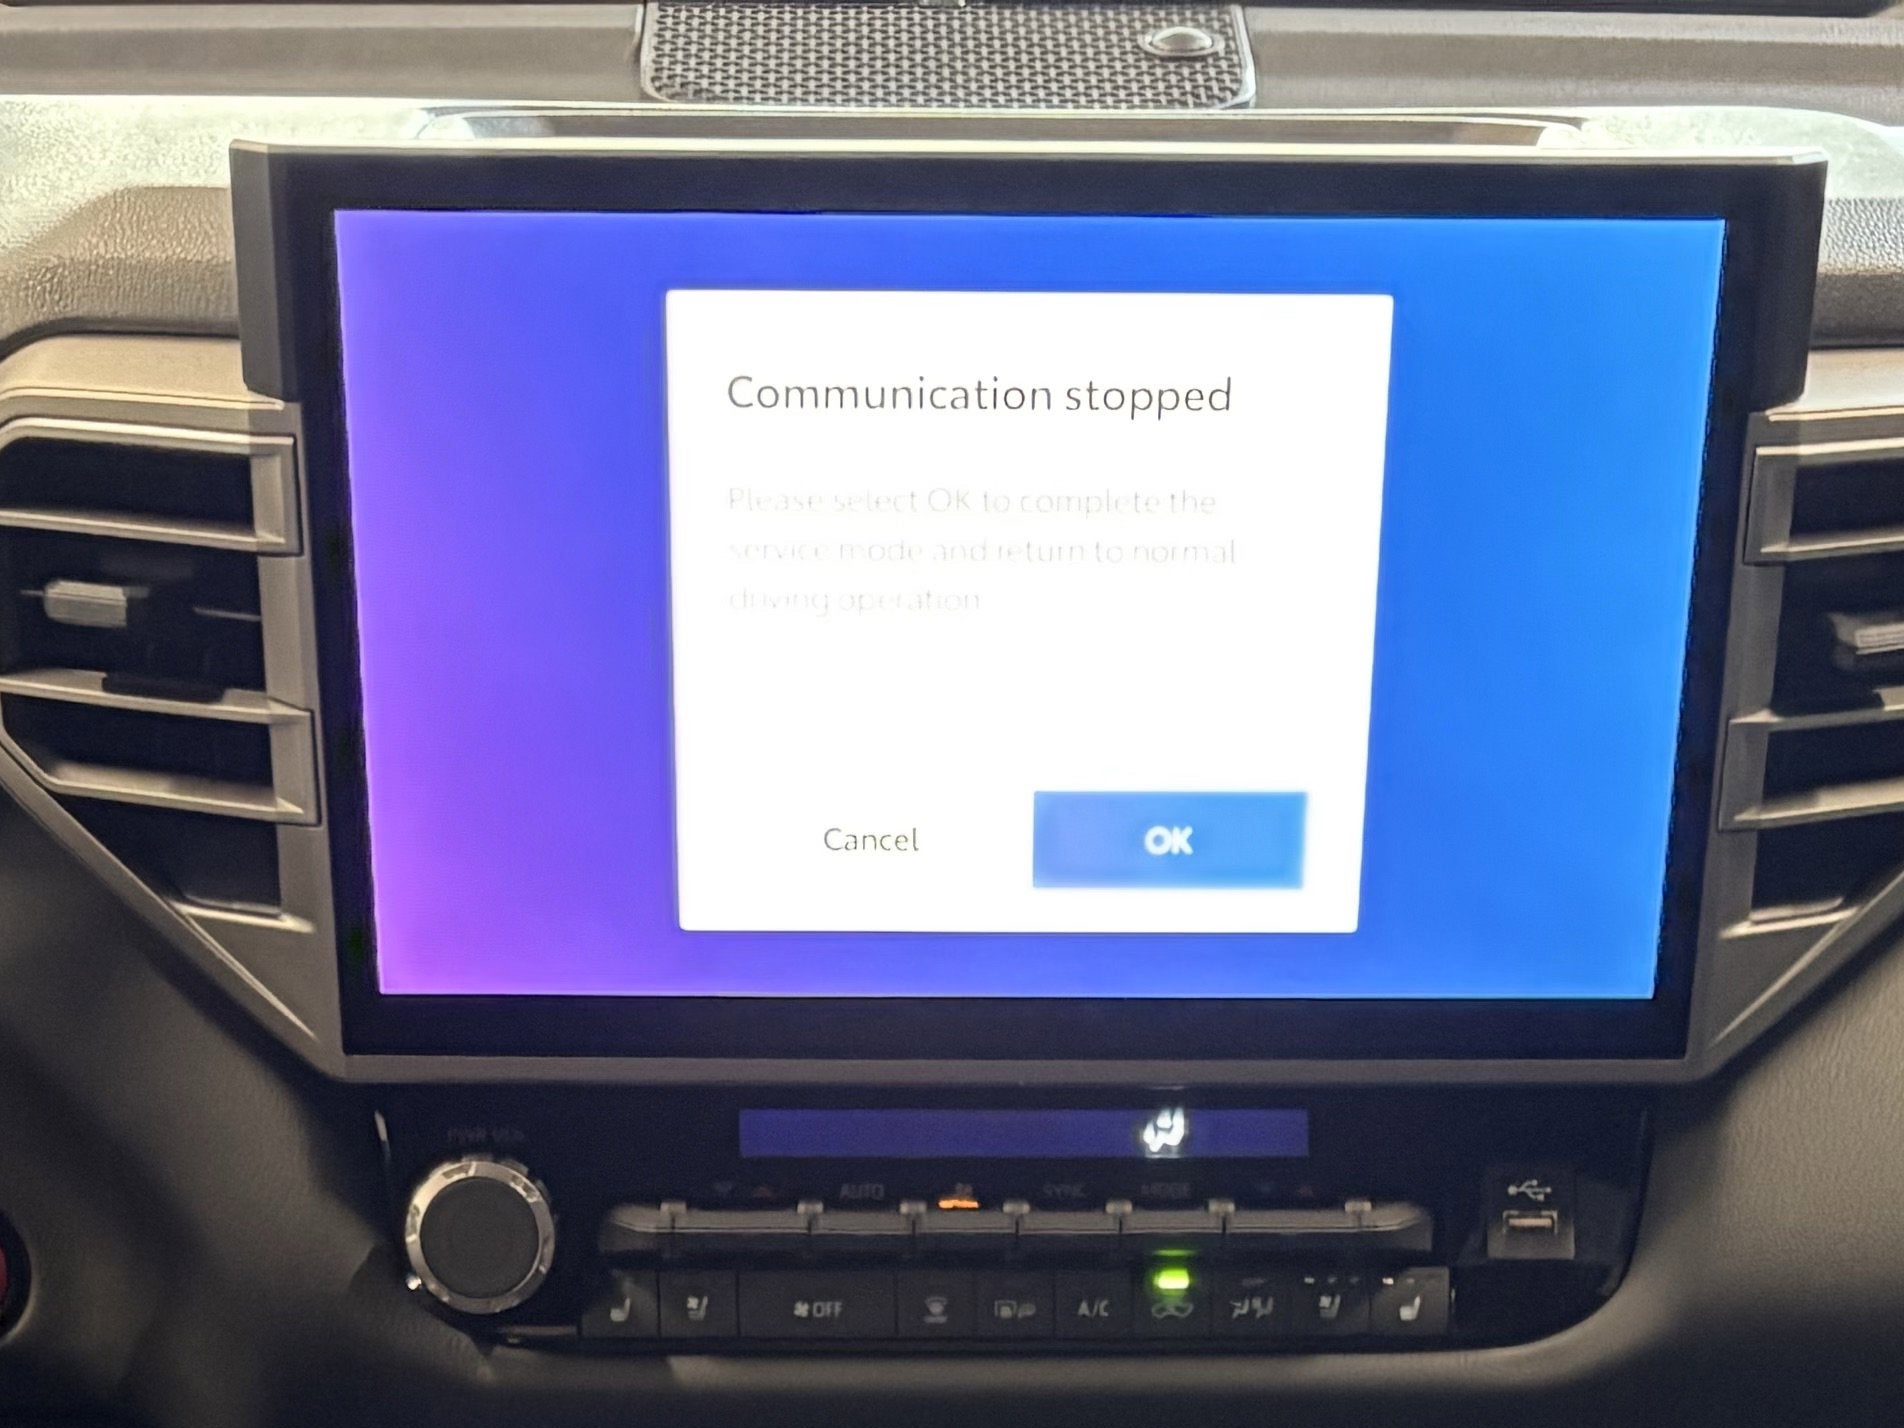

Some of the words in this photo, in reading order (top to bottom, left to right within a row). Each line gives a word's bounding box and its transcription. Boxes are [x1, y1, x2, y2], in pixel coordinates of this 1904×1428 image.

[727, 375, 1053, 412] Communication
[1064, 376, 1234, 420] stopped
[927, 488, 972, 514] OK
[983, 490, 1011, 515] to
[1020, 489, 1160, 519] complete
[1170, 489, 1217, 515] the
[1094, 540, 1124, 564] to
[823, 828, 920, 853] Cancel
[1143, 826, 1194, 855] OK
[812, 1301, 843, 1318] OFF
[1077, 1299, 1109, 1317] A/C
